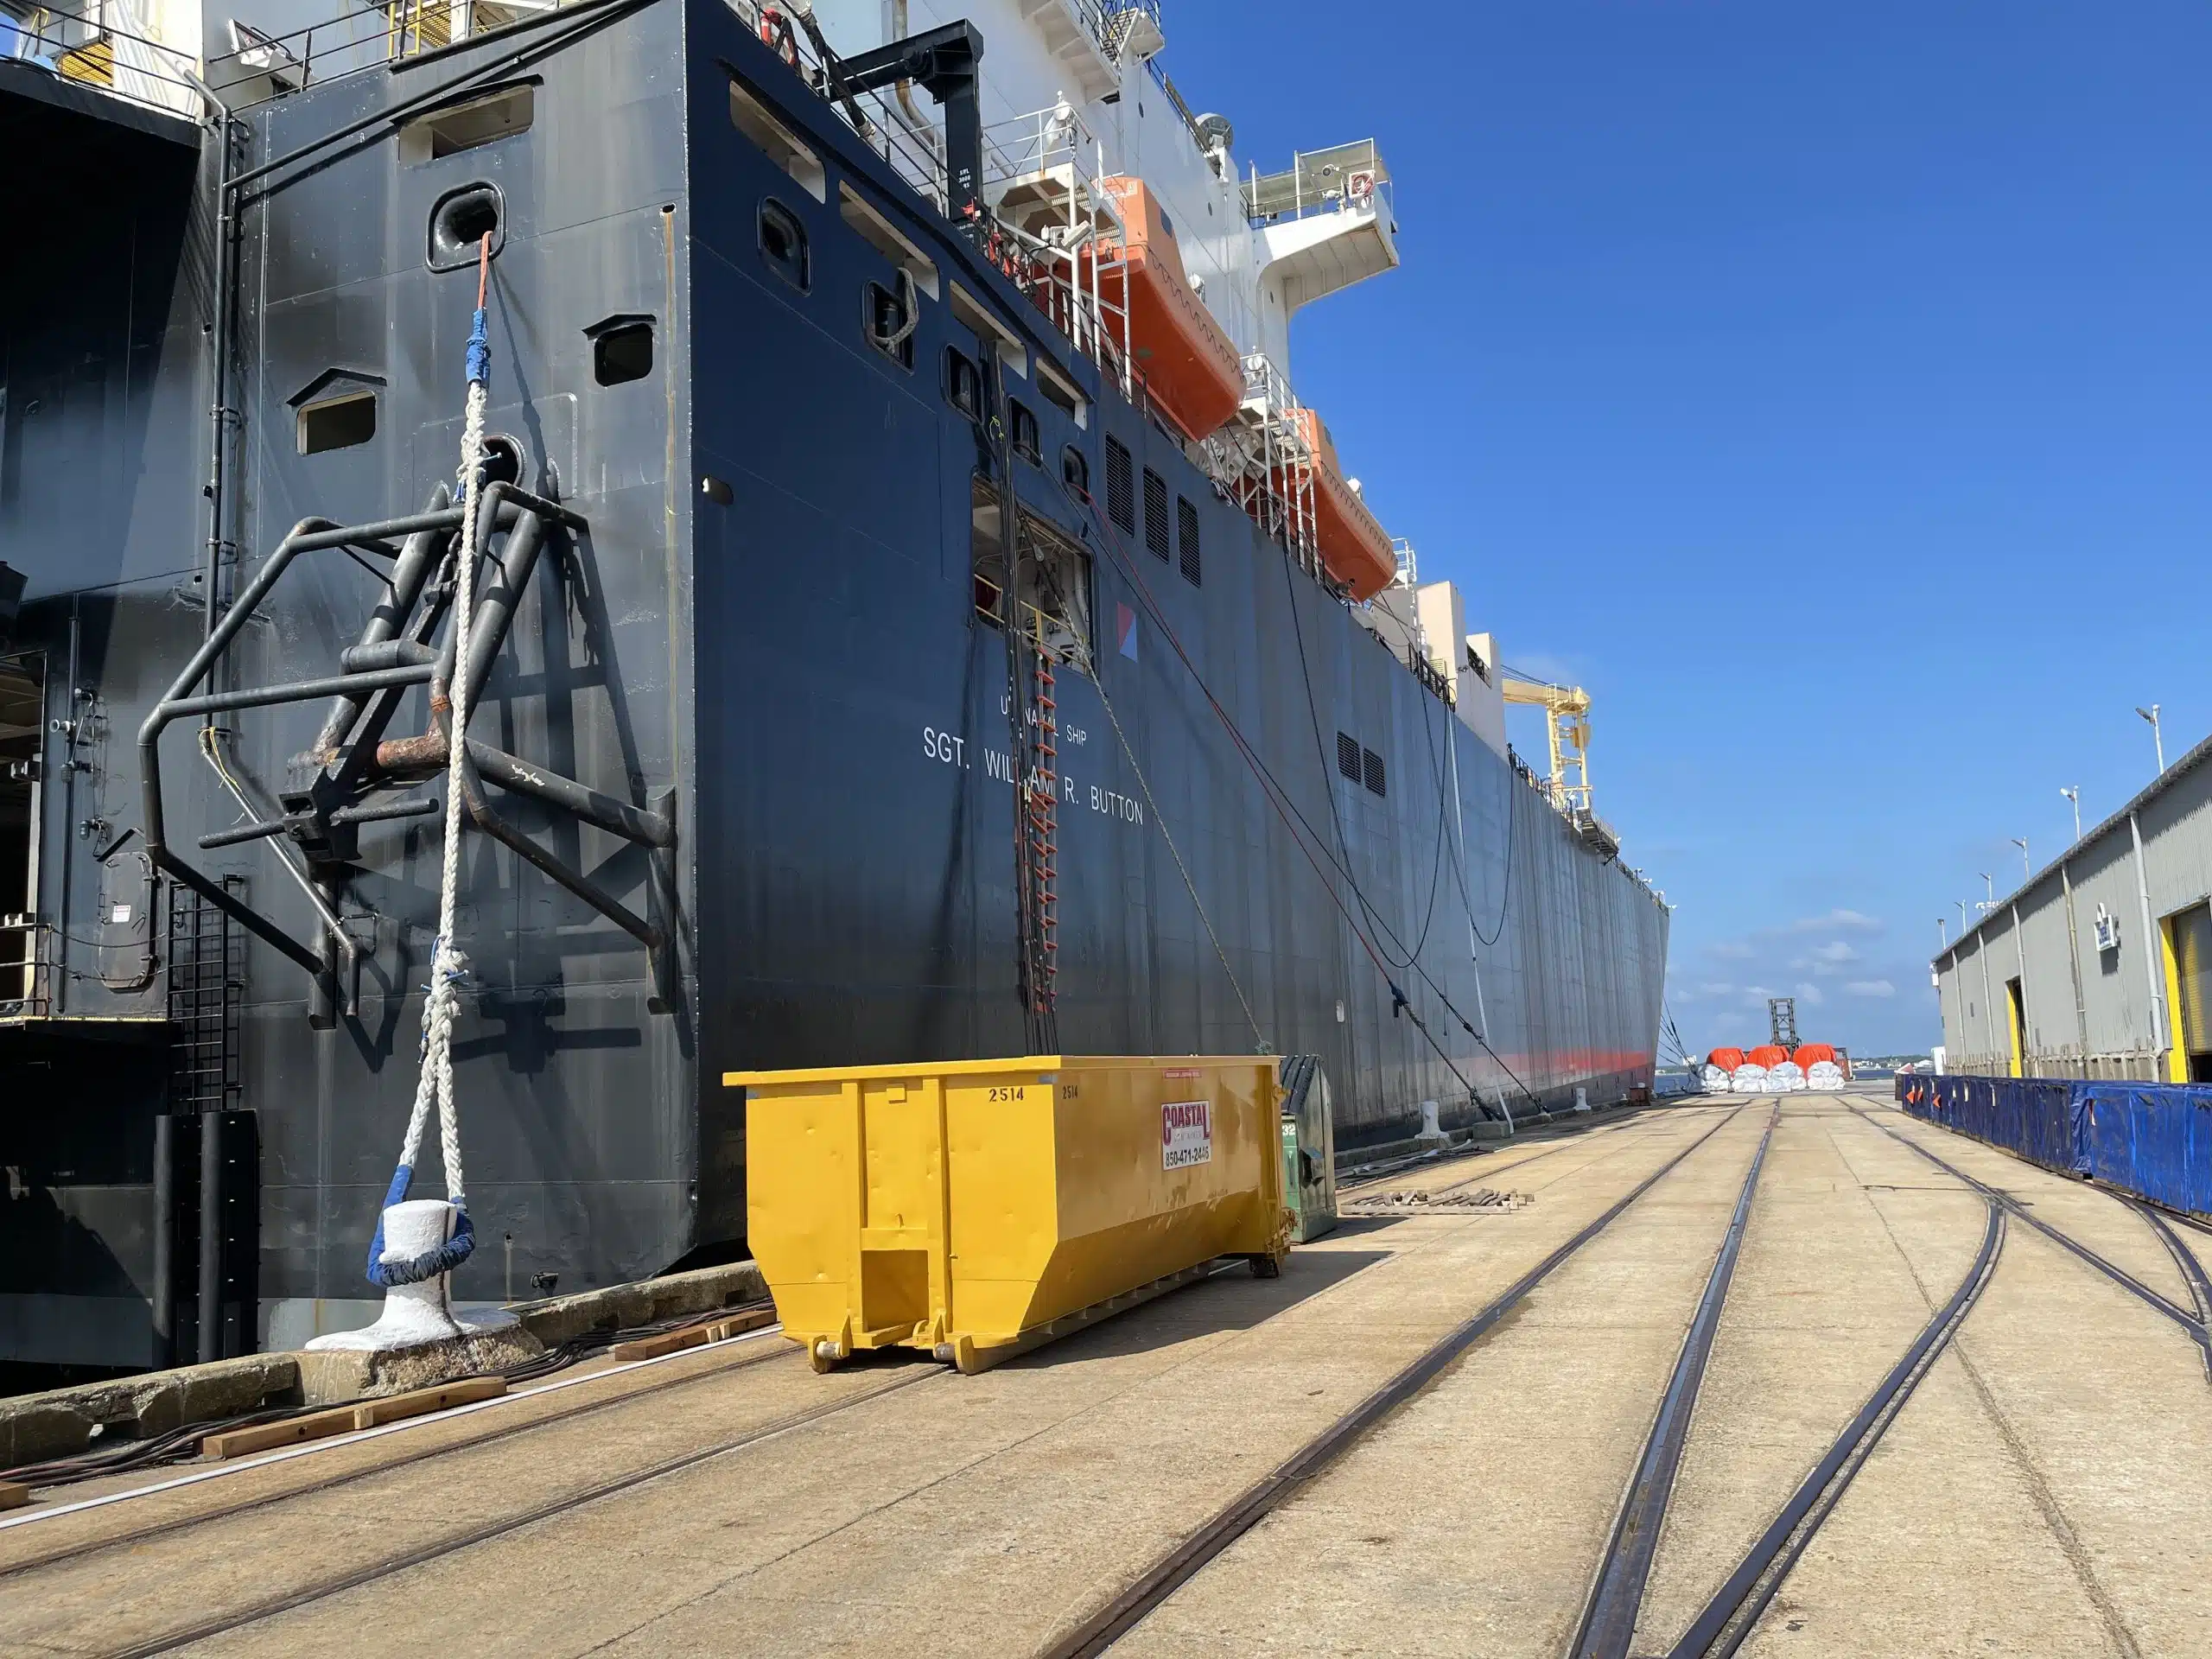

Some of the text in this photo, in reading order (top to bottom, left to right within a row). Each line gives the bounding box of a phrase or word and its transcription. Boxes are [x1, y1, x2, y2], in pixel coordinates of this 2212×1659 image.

[1066, 724, 1087, 746] SHIP
[924, 727, 1143, 825] SGT. WILAM R. BUTTON
[989, 1087, 1024, 1103] 2514
[1062, 1085, 1078, 1099] 2514
[1162, 1103, 1211, 1146] COASTAL
[1166, 1146, 1210, 1166] 850-471-2446
